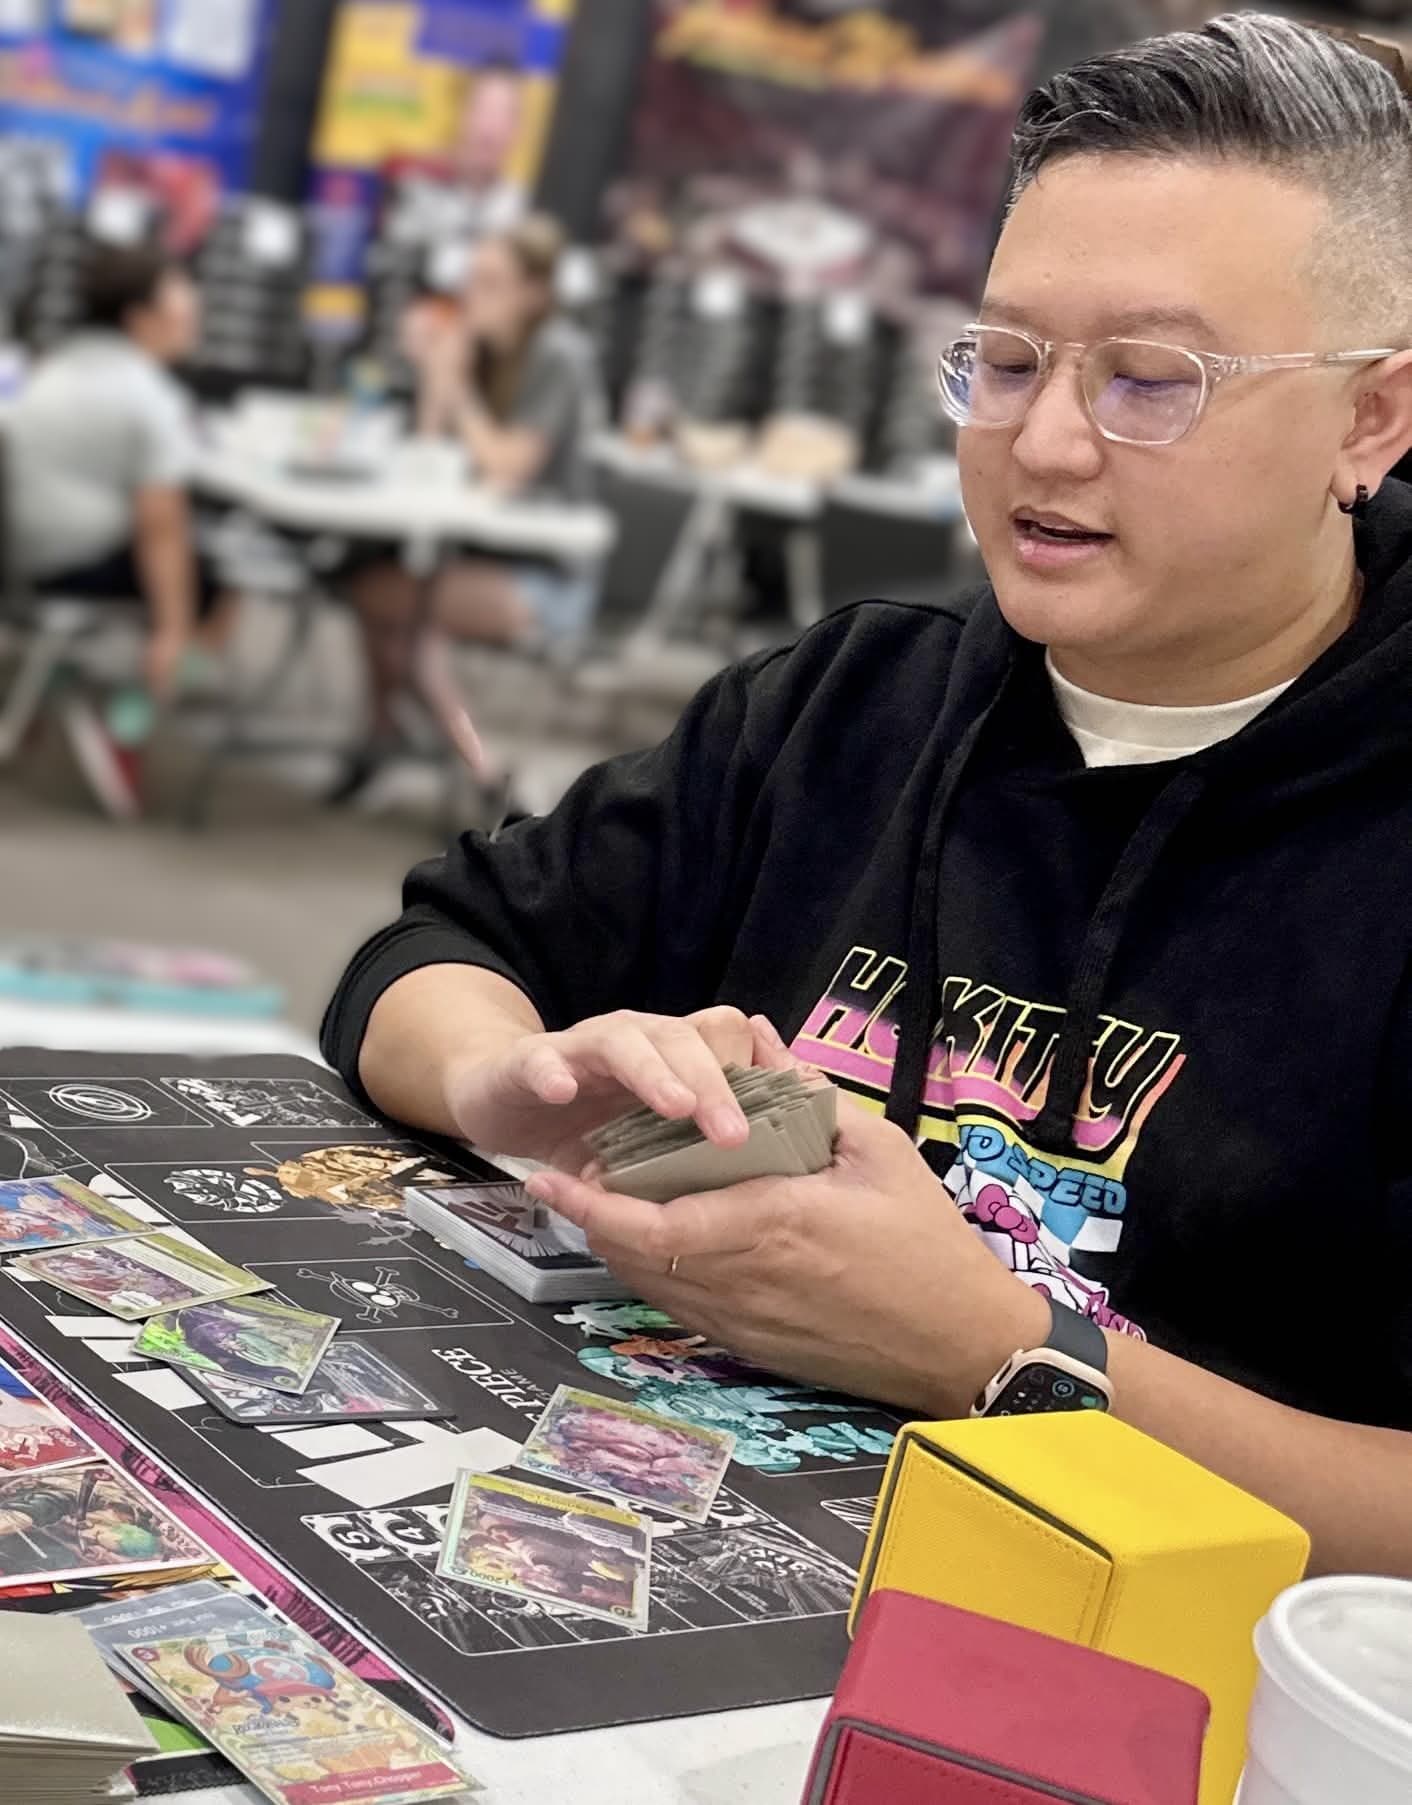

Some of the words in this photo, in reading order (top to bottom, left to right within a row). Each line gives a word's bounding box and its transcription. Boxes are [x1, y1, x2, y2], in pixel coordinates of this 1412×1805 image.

[941, 976, 1186, 1146] KITY
[432, 1347, 545, 1409] PIECE
[499, 1367, 552, 1401] GAME
[336, 1530, 370, 1544] 5
[395, 1526, 426, 1541] 4
[470, 1570, 510, 1586] 12000
